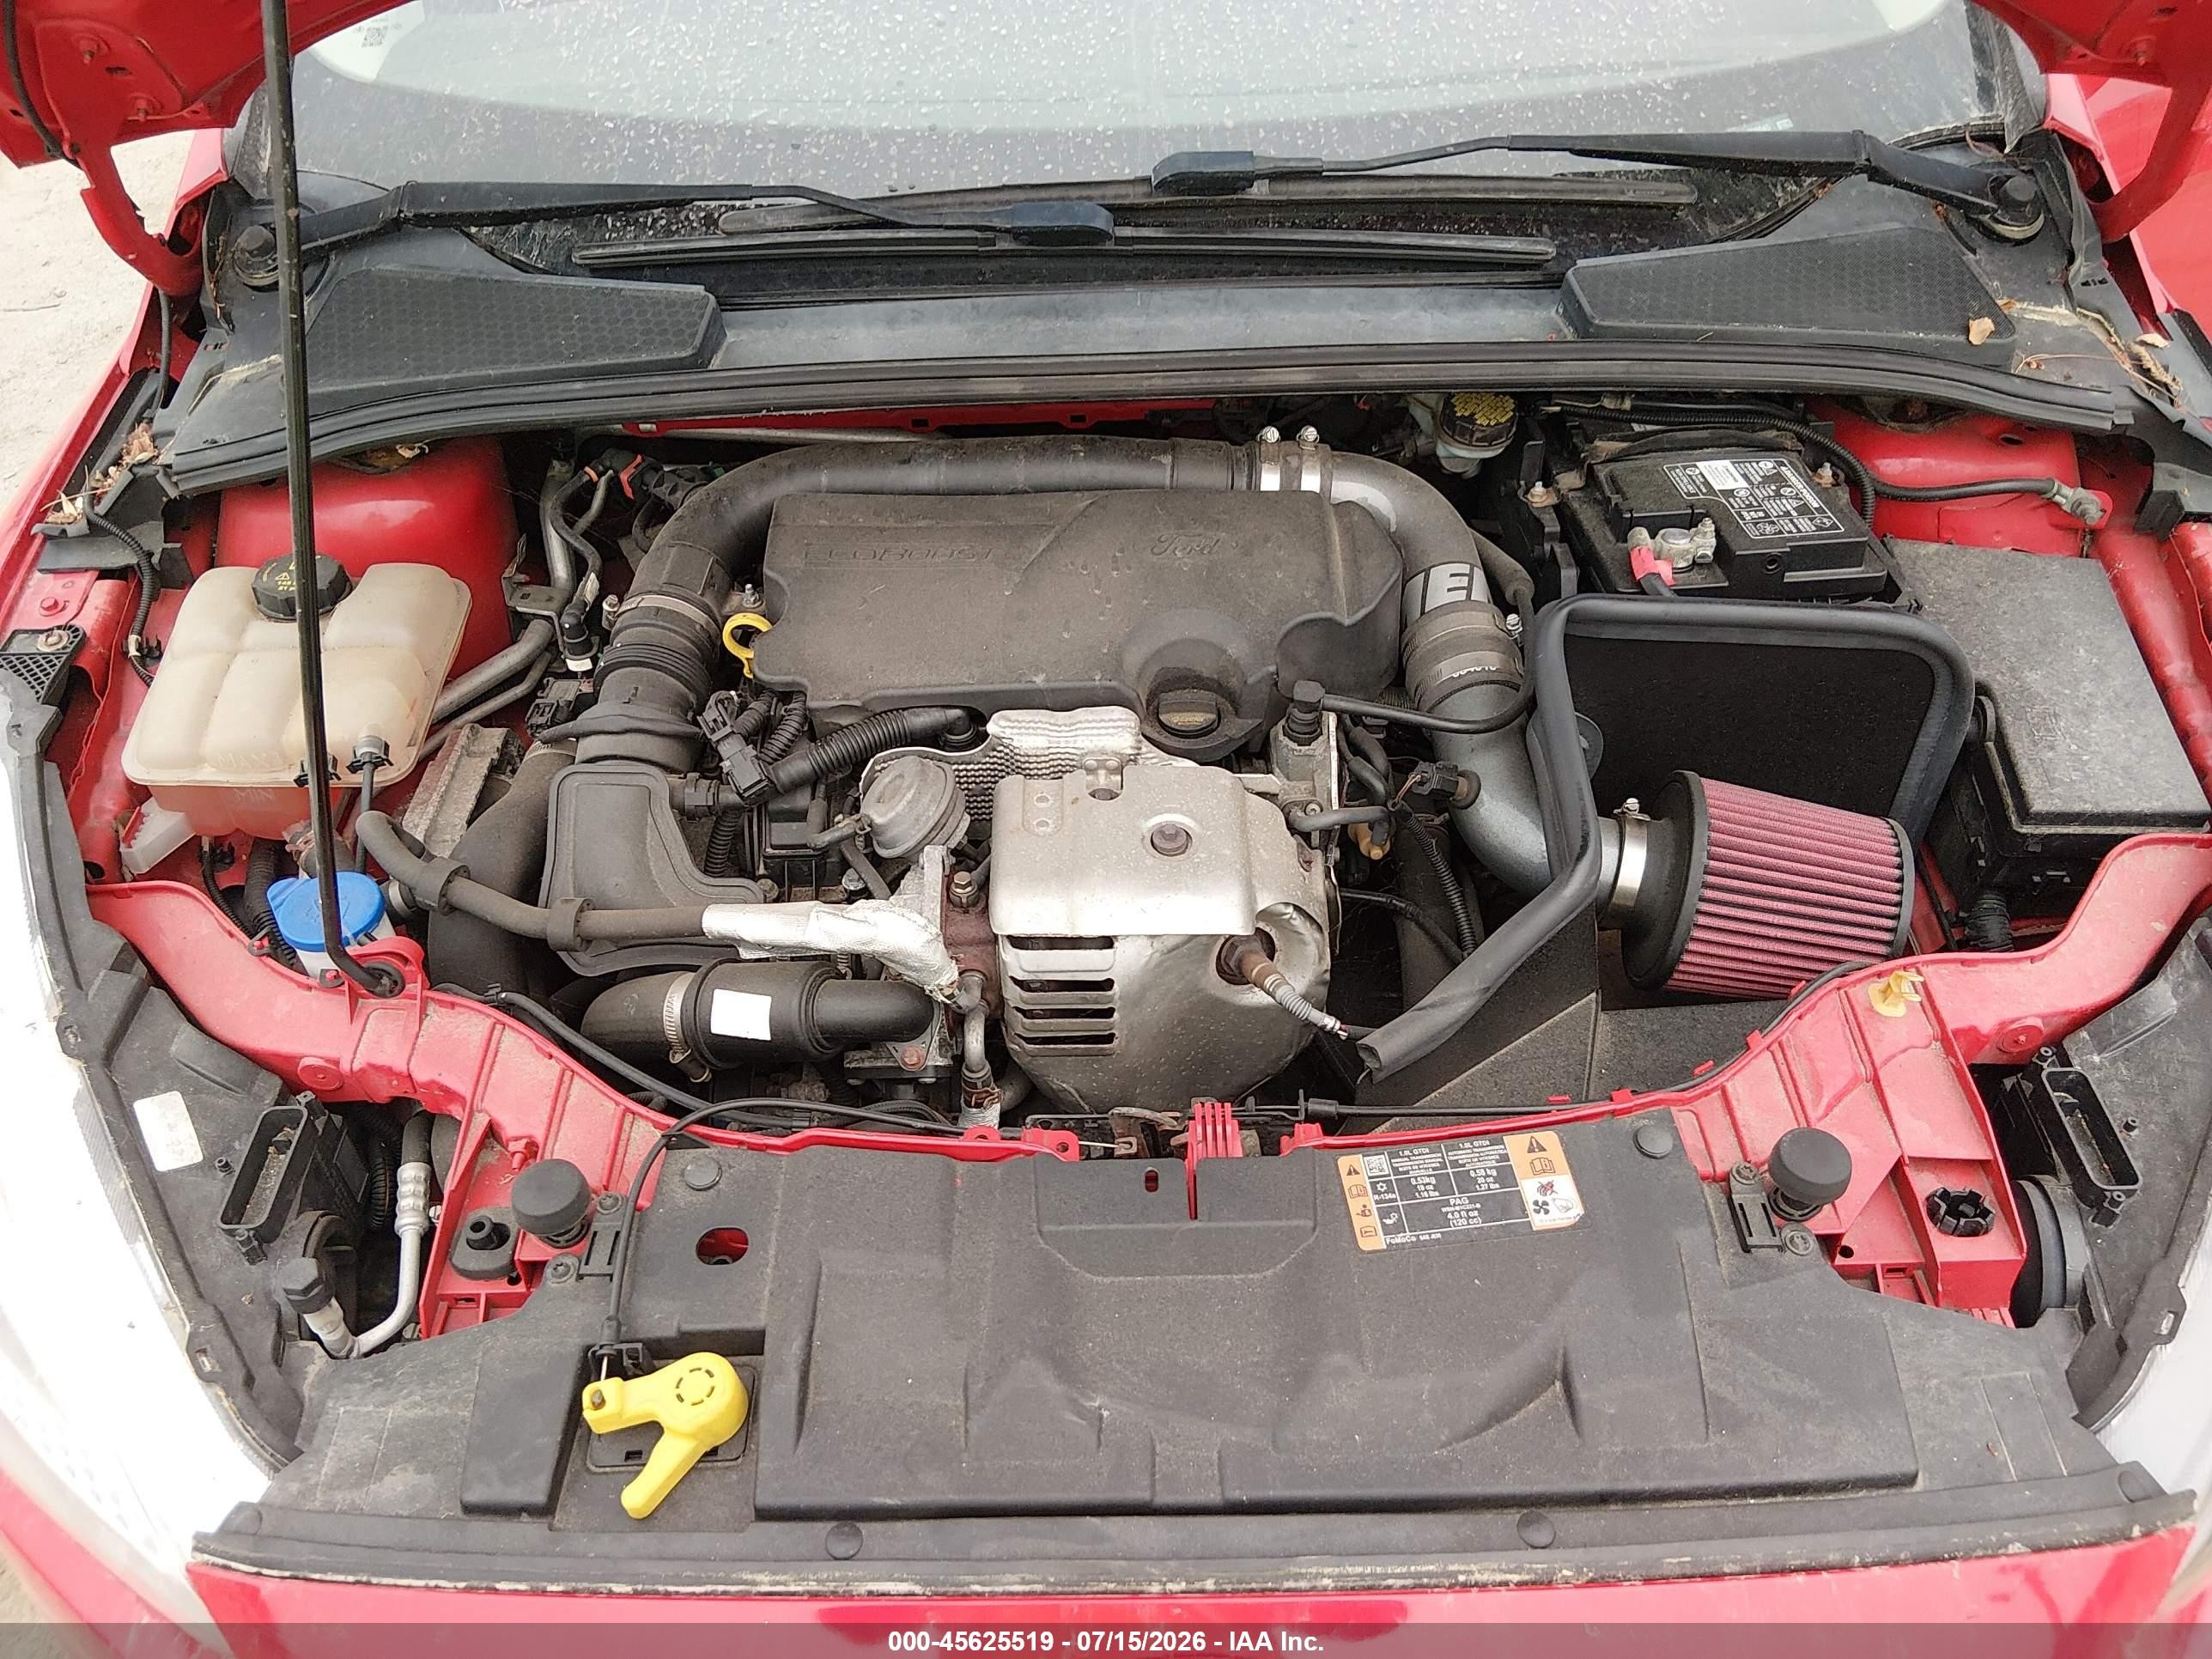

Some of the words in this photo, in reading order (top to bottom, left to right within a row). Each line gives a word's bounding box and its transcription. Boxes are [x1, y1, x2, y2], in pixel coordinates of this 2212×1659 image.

[1486, 1168, 1498, 1176] kg
[1373, 1192, 1396, 1201] R-134a
[1449, 1196, 1469, 1206] PAG
[1447, 1211, 1460, 1219] 4.0
[1449, 1218, 1468, 1228] (120
[1468, 1216, 1482, 1224] cc)
[1386, 1235, 1416, 1245] FoMoCo
